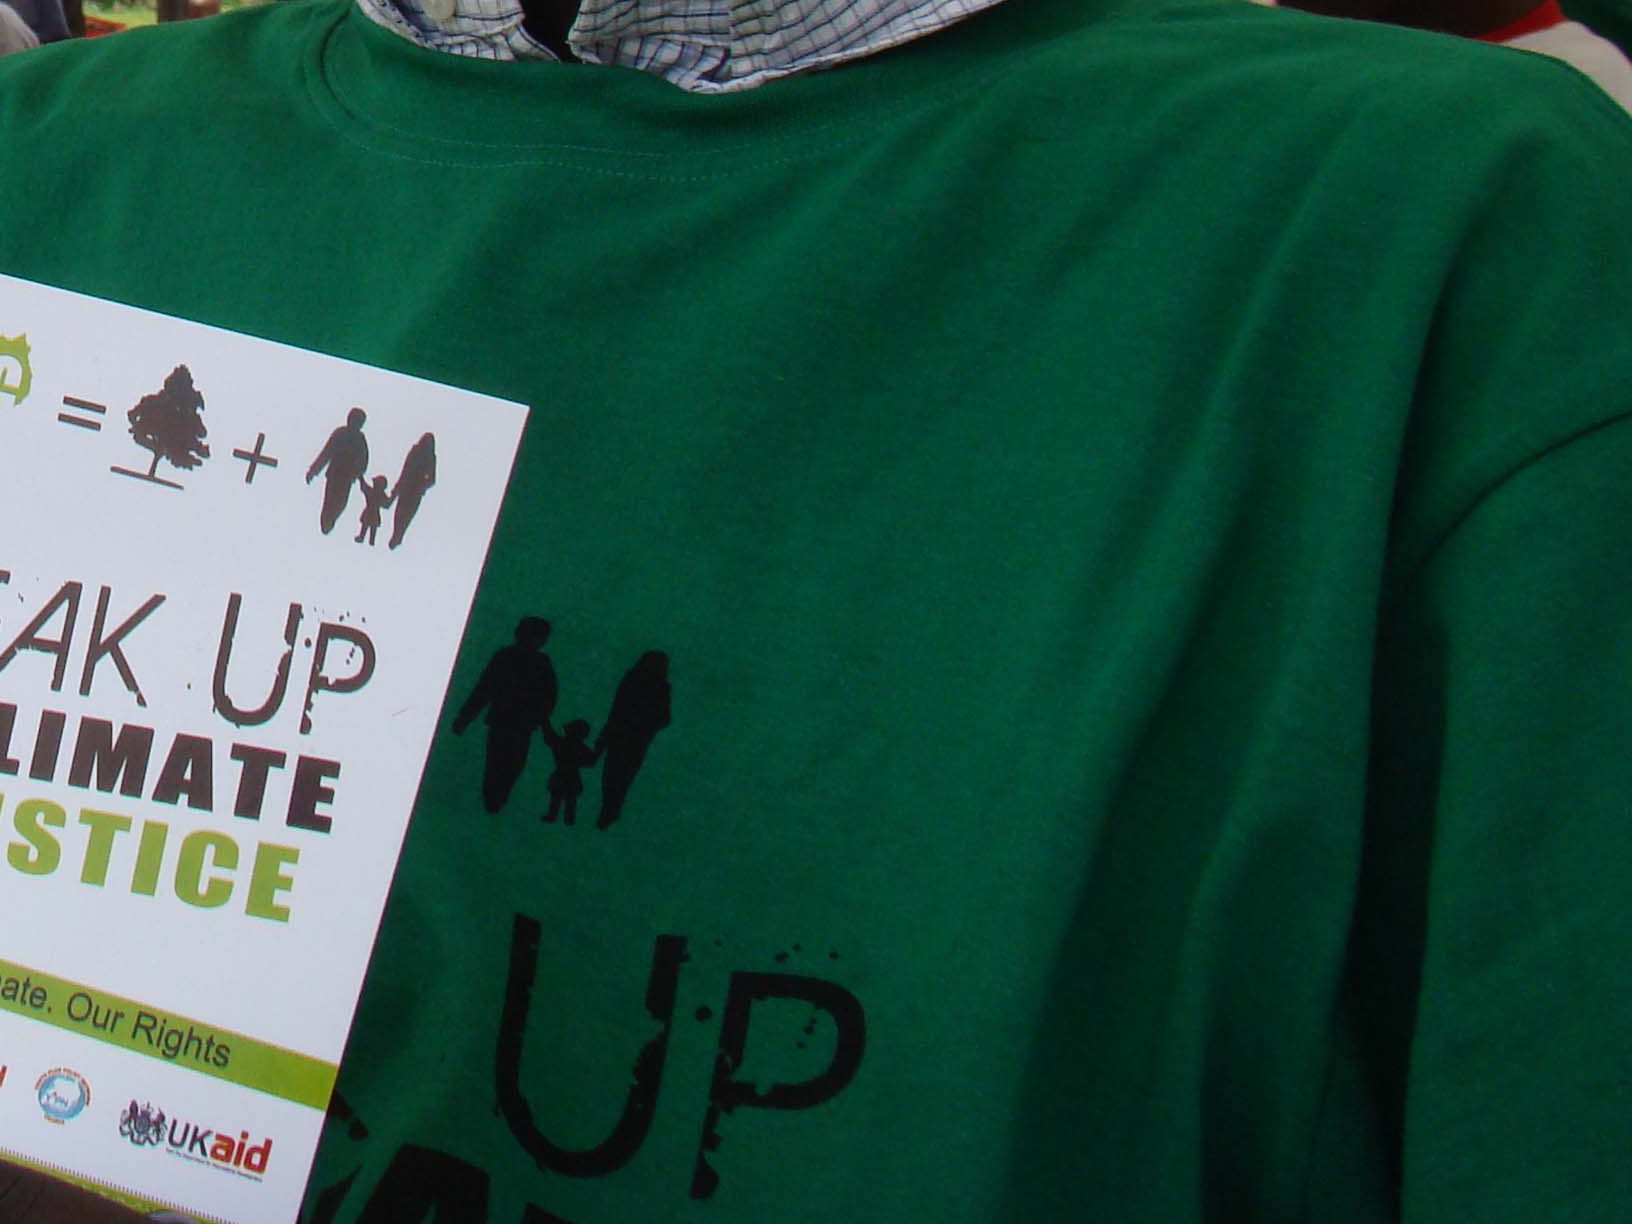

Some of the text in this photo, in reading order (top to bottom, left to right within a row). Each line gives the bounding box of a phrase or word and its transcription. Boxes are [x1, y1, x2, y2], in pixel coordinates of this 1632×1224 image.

[212, 592, 377, 736] UP
[66, 992, 125, 1034] Our
[133, 1010, 232, 1068] Rights
[493, 913, 867, 1200] UP
[167, 1118, 273, 1175] UKaid
